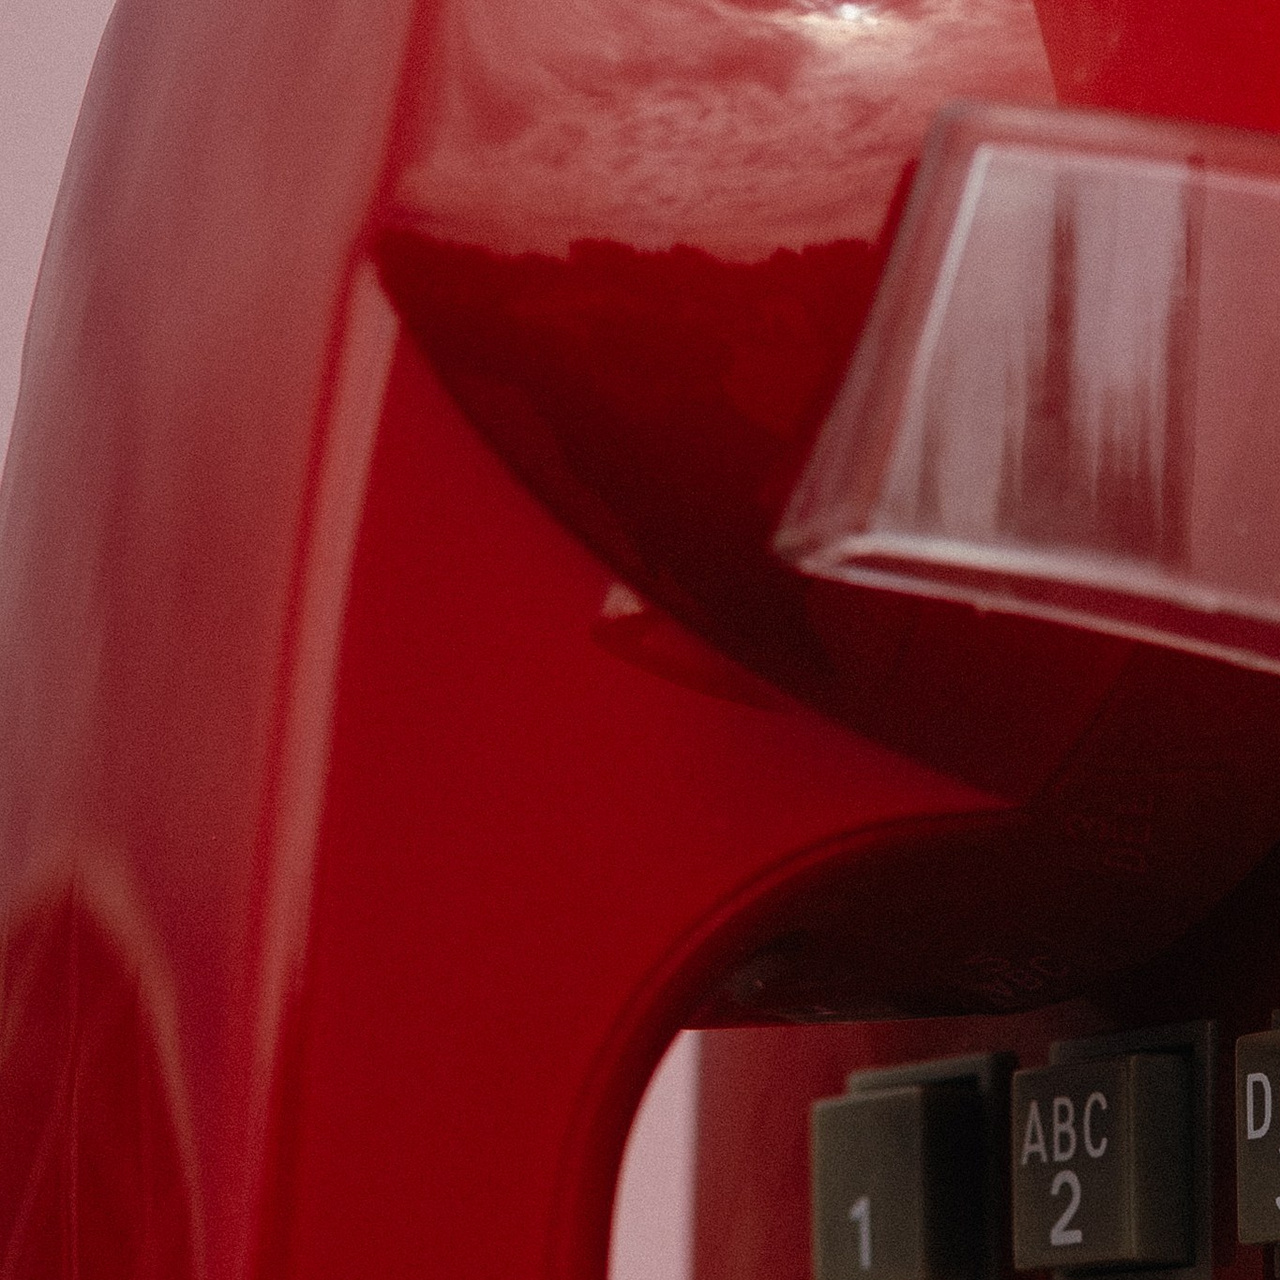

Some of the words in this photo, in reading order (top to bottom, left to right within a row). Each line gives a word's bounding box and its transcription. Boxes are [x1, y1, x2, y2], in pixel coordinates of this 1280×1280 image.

[1020, 1092, 1108, 1166] ABC
[850, 1197, 871, 1269] 1
[1049, 1170, 1083, 1246] 2
